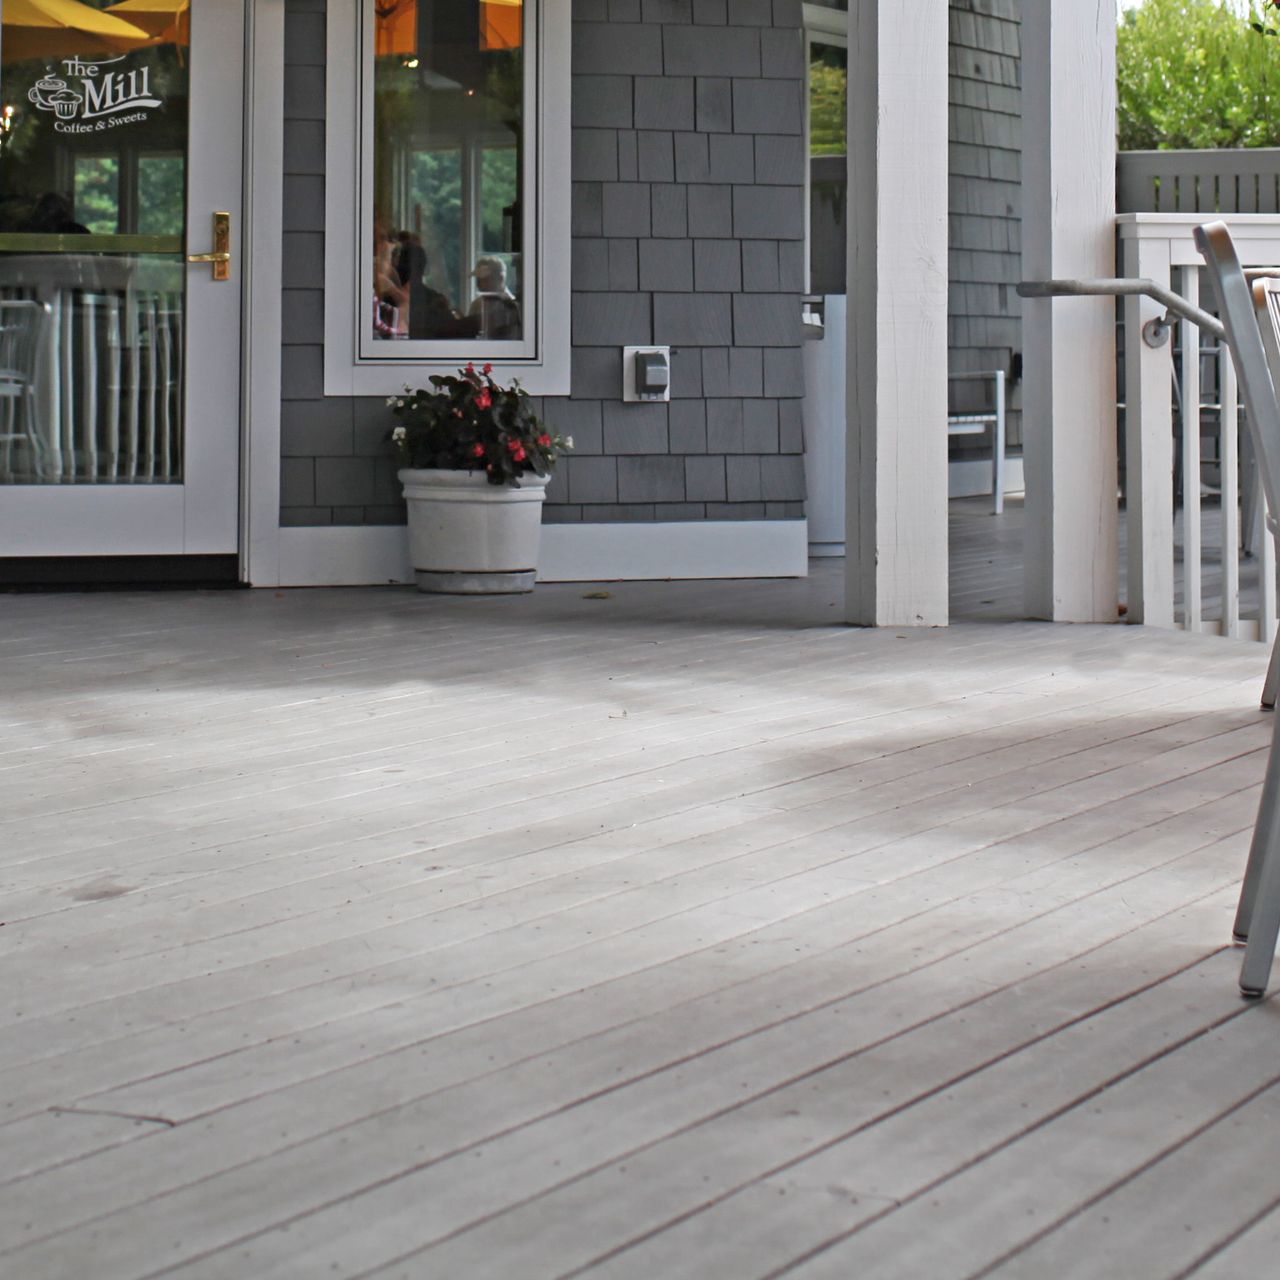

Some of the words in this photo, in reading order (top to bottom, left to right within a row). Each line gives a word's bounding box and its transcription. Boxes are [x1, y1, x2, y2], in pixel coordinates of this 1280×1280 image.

[61, 54, 126, 77] The
[81, 66, 162, 118] Mill
[54, 121, 94, 134] Coffee
[95, 121, 106, 131] &
[107, 111, 148, 128] Sweets
